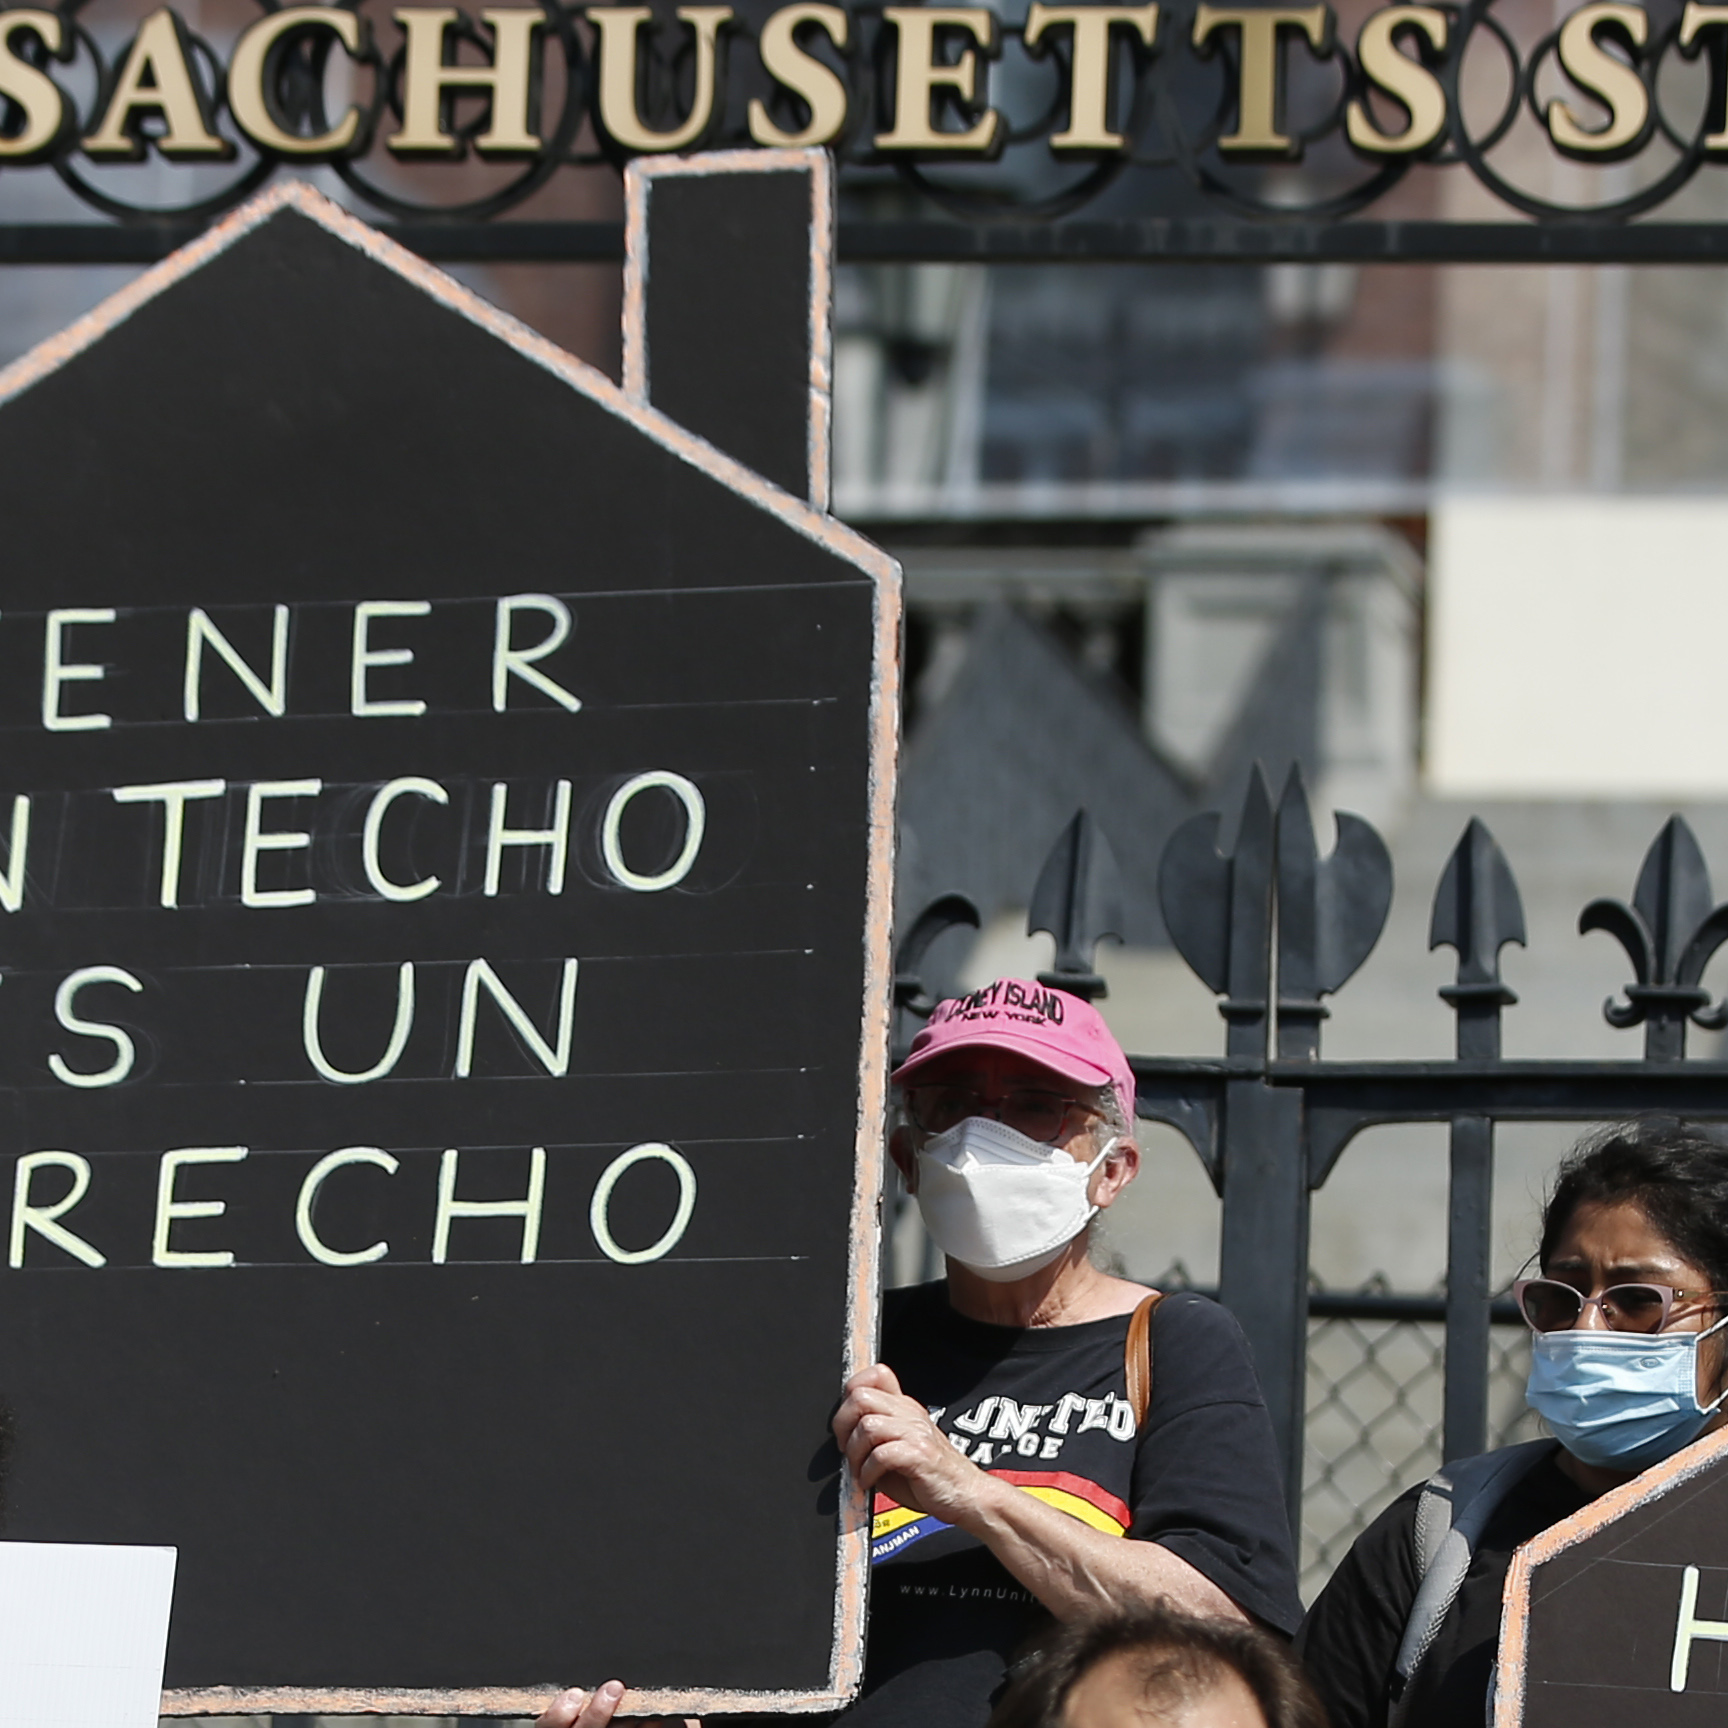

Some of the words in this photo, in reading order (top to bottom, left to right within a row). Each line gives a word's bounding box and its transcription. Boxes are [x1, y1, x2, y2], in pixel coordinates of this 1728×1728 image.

[112, 769, 705, 910] TECHO
[303, 957, 579, 1084] UN
[961, 1011, 1000, 1022] NEW
[1005, 1010, 1048, 1027] YORK
[1004, 981, 1065, 1026] ISLAND
